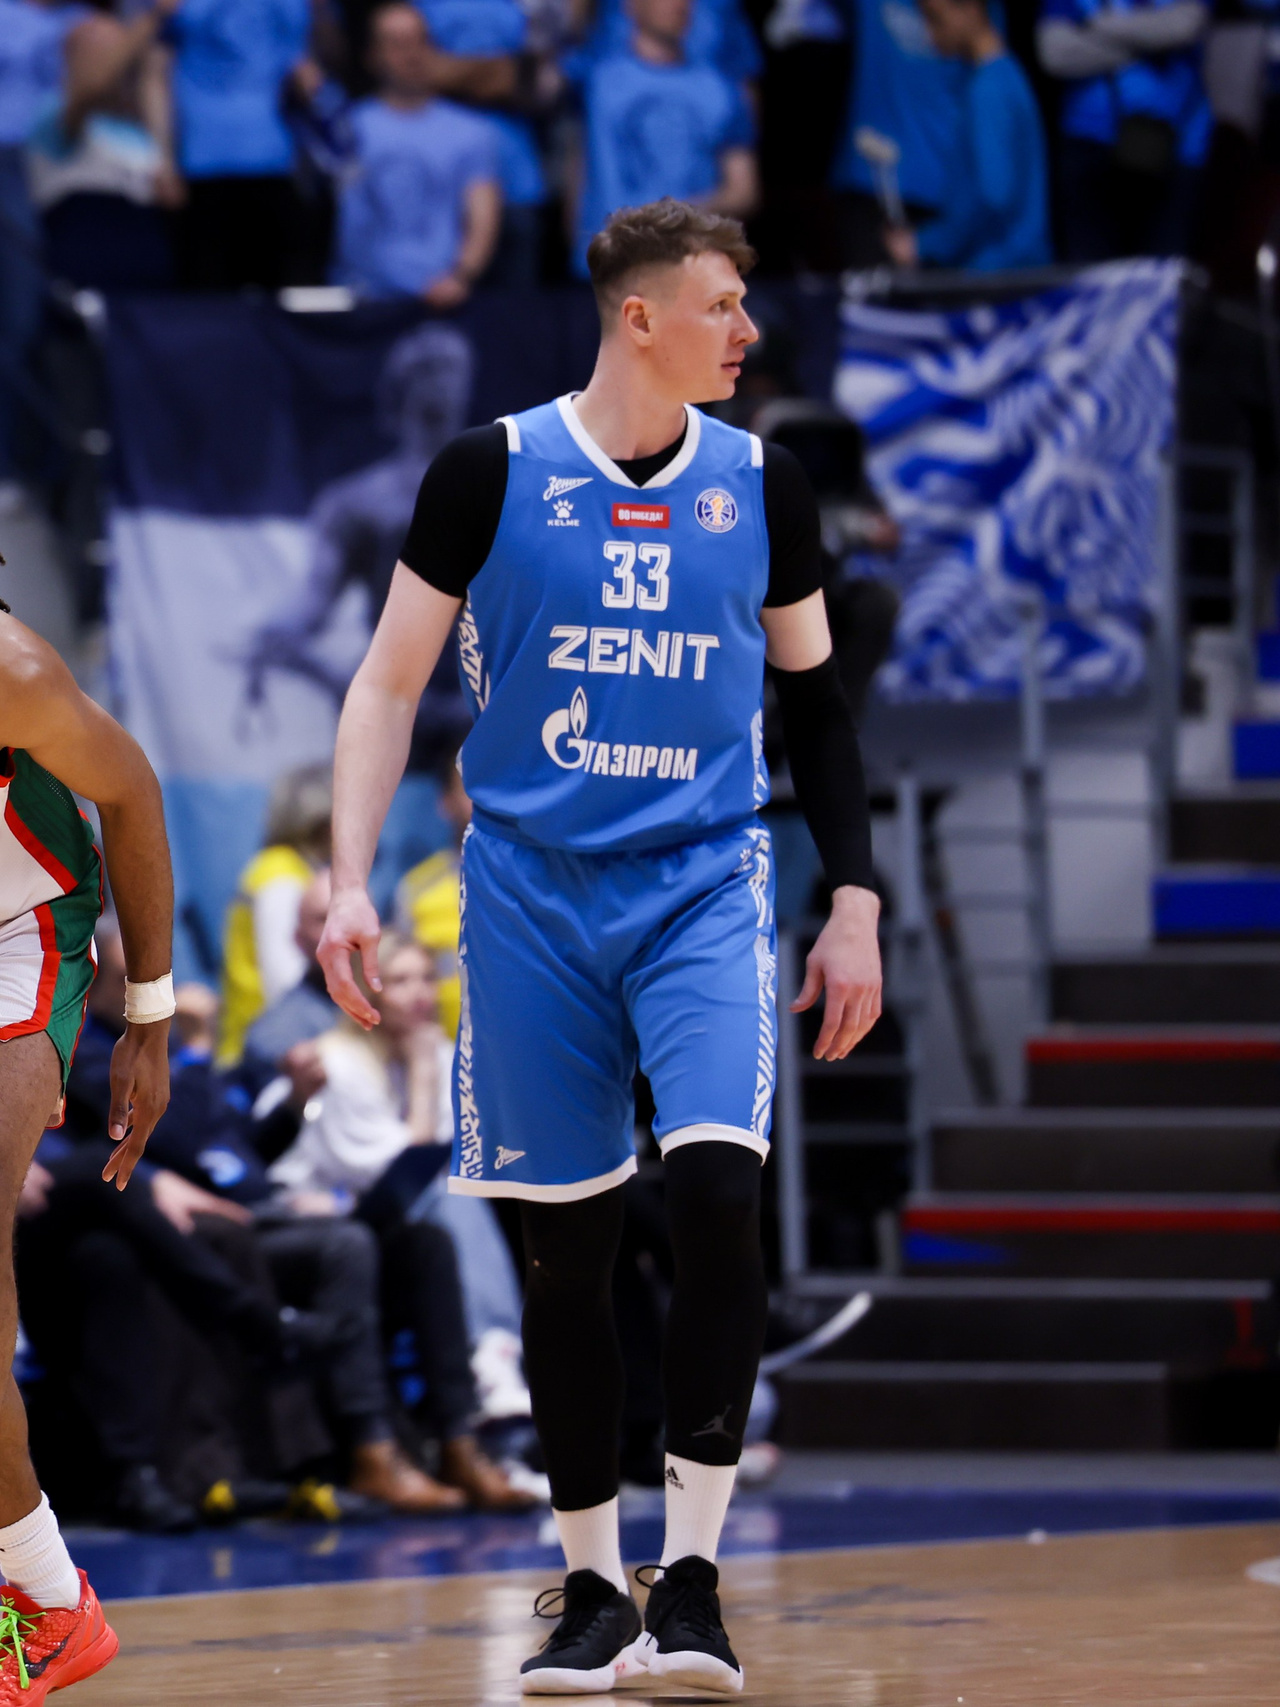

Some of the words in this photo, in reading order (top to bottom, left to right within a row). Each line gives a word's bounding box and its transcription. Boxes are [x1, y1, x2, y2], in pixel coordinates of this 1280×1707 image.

[547, 519, 580, 527] KELME
[601, 540, 671, 611] 33
[548, 625, 720, 681] ZENIT
[584, 740, 698, 781] ГАЗПРОМ
